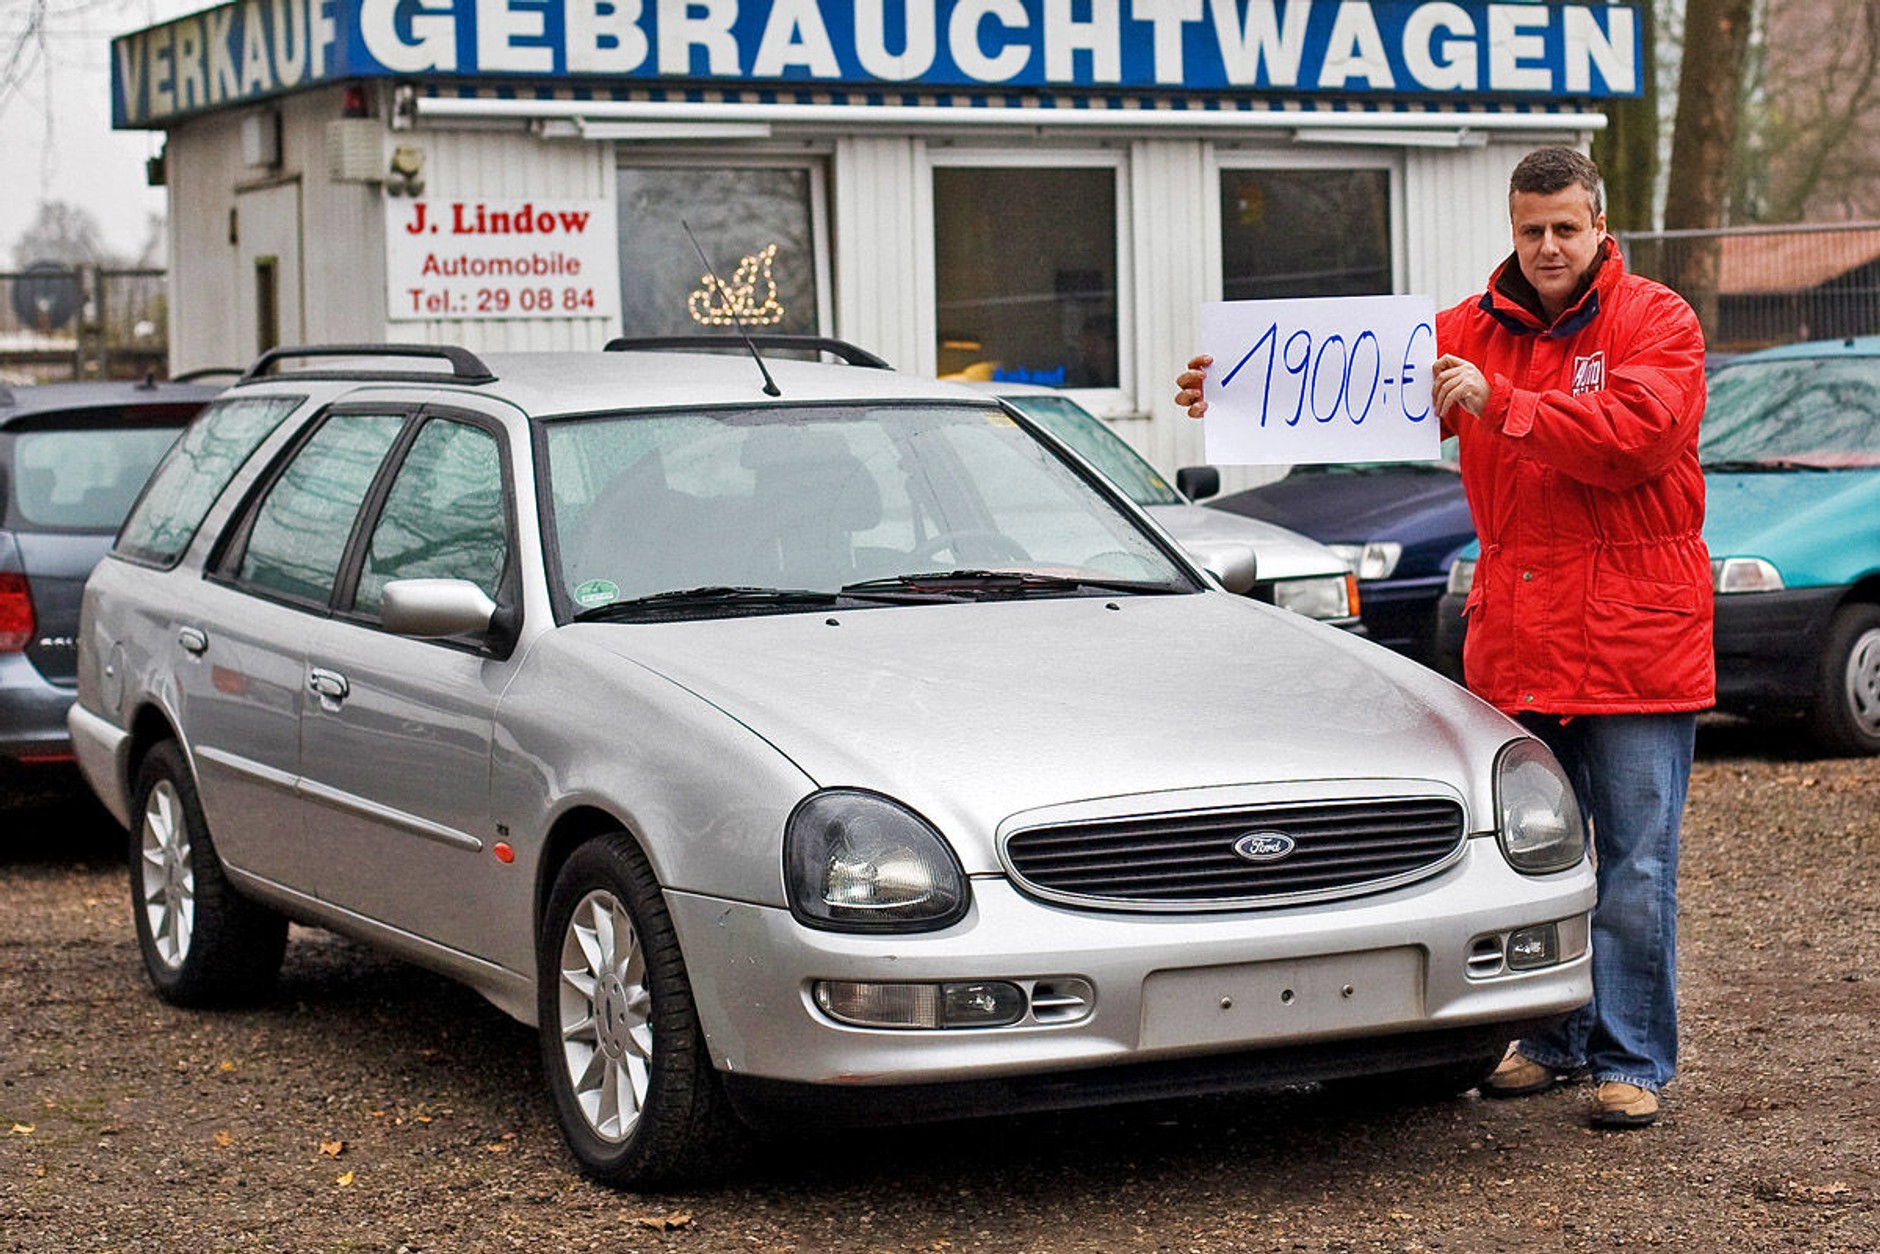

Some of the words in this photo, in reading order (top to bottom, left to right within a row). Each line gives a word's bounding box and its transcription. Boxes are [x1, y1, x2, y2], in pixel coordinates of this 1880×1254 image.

[360, 0, 1635, 93] GEBRAUCHTWAGEN
[117, 0, 336, 124] VERKAUF
[406, 203, 438, 234] J.
[452, 203, 590, 234] Lindow
[422, 253, 581, 277] Automobile
[407, 287, 467, 313] Tel.:
[477, 287, 510, 311] 29
[519, 287, 553, 311] 08
[563, 287, 594, 310] 84
[1250, 838, 1281, 853] Ford
